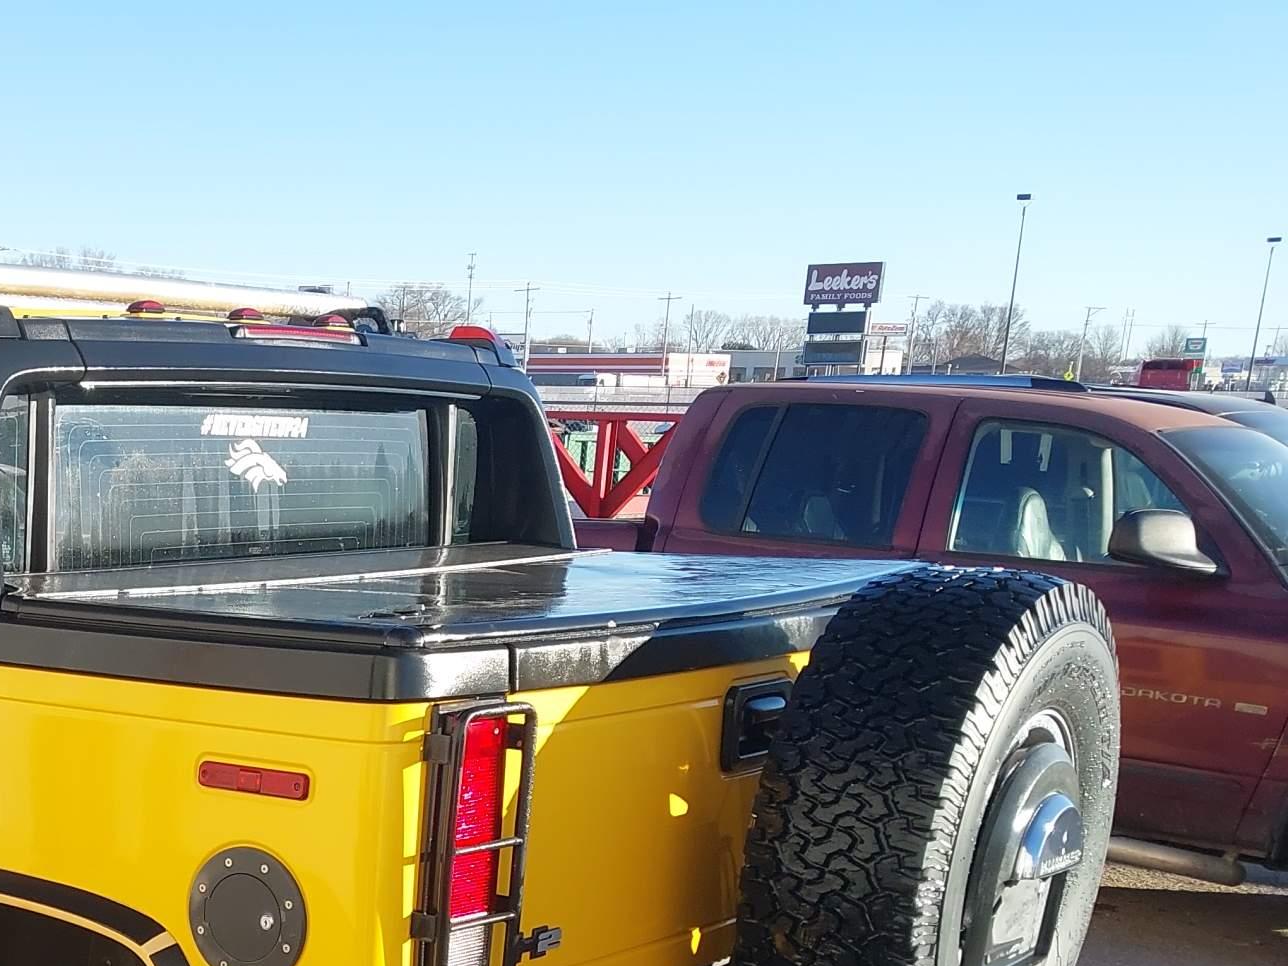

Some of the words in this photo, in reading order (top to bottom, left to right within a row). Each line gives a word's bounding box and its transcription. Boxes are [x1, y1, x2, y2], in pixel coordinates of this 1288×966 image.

[808, 268, 879, 291] Leeker's
[810, 293, 841, 301] FAMILY
[844, 292, 873, 300] FOODS
